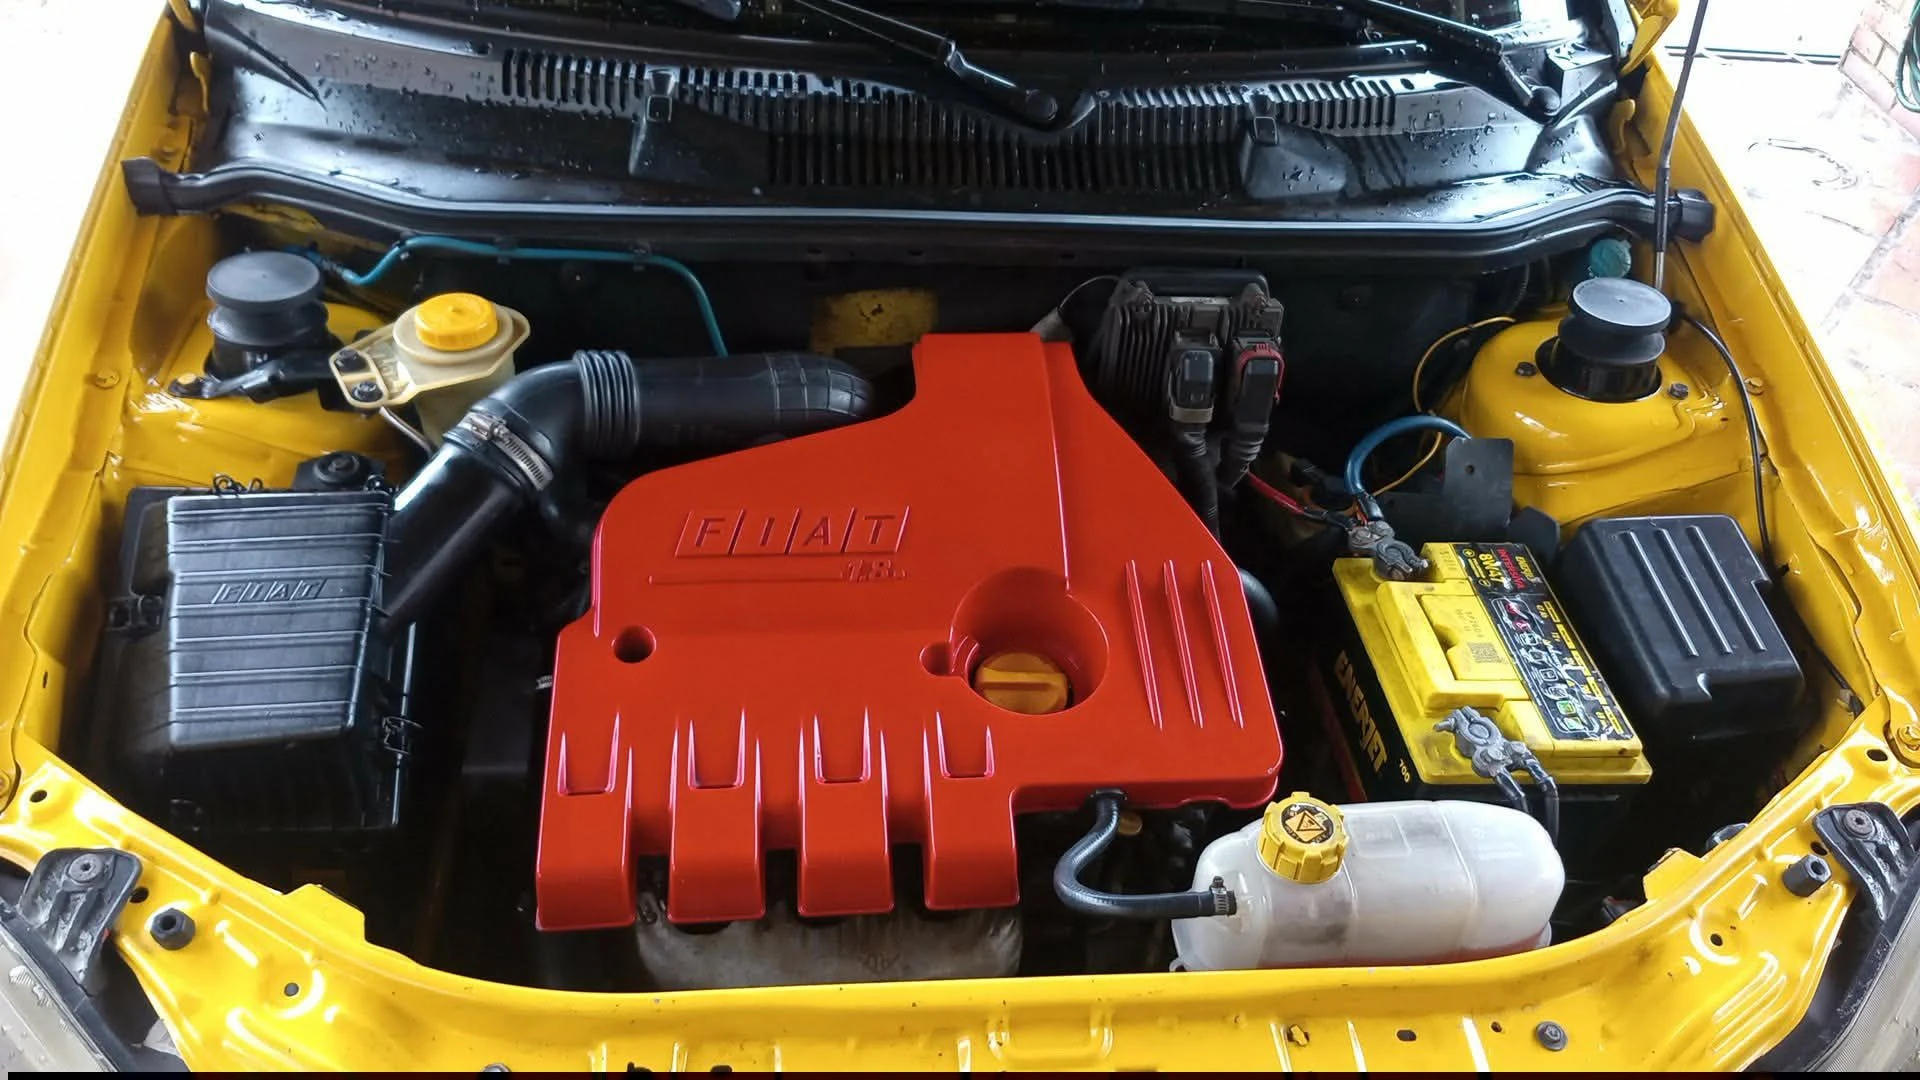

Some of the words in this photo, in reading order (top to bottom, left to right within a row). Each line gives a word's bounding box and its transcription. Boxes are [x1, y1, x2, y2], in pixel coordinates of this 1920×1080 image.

[686, 511, 901, 550] FIAT
[219, 581, 322, 601] FIAT
[1335, 651, 1387, 772] ENERJET
[1399, 758, 1410, 783] 700
